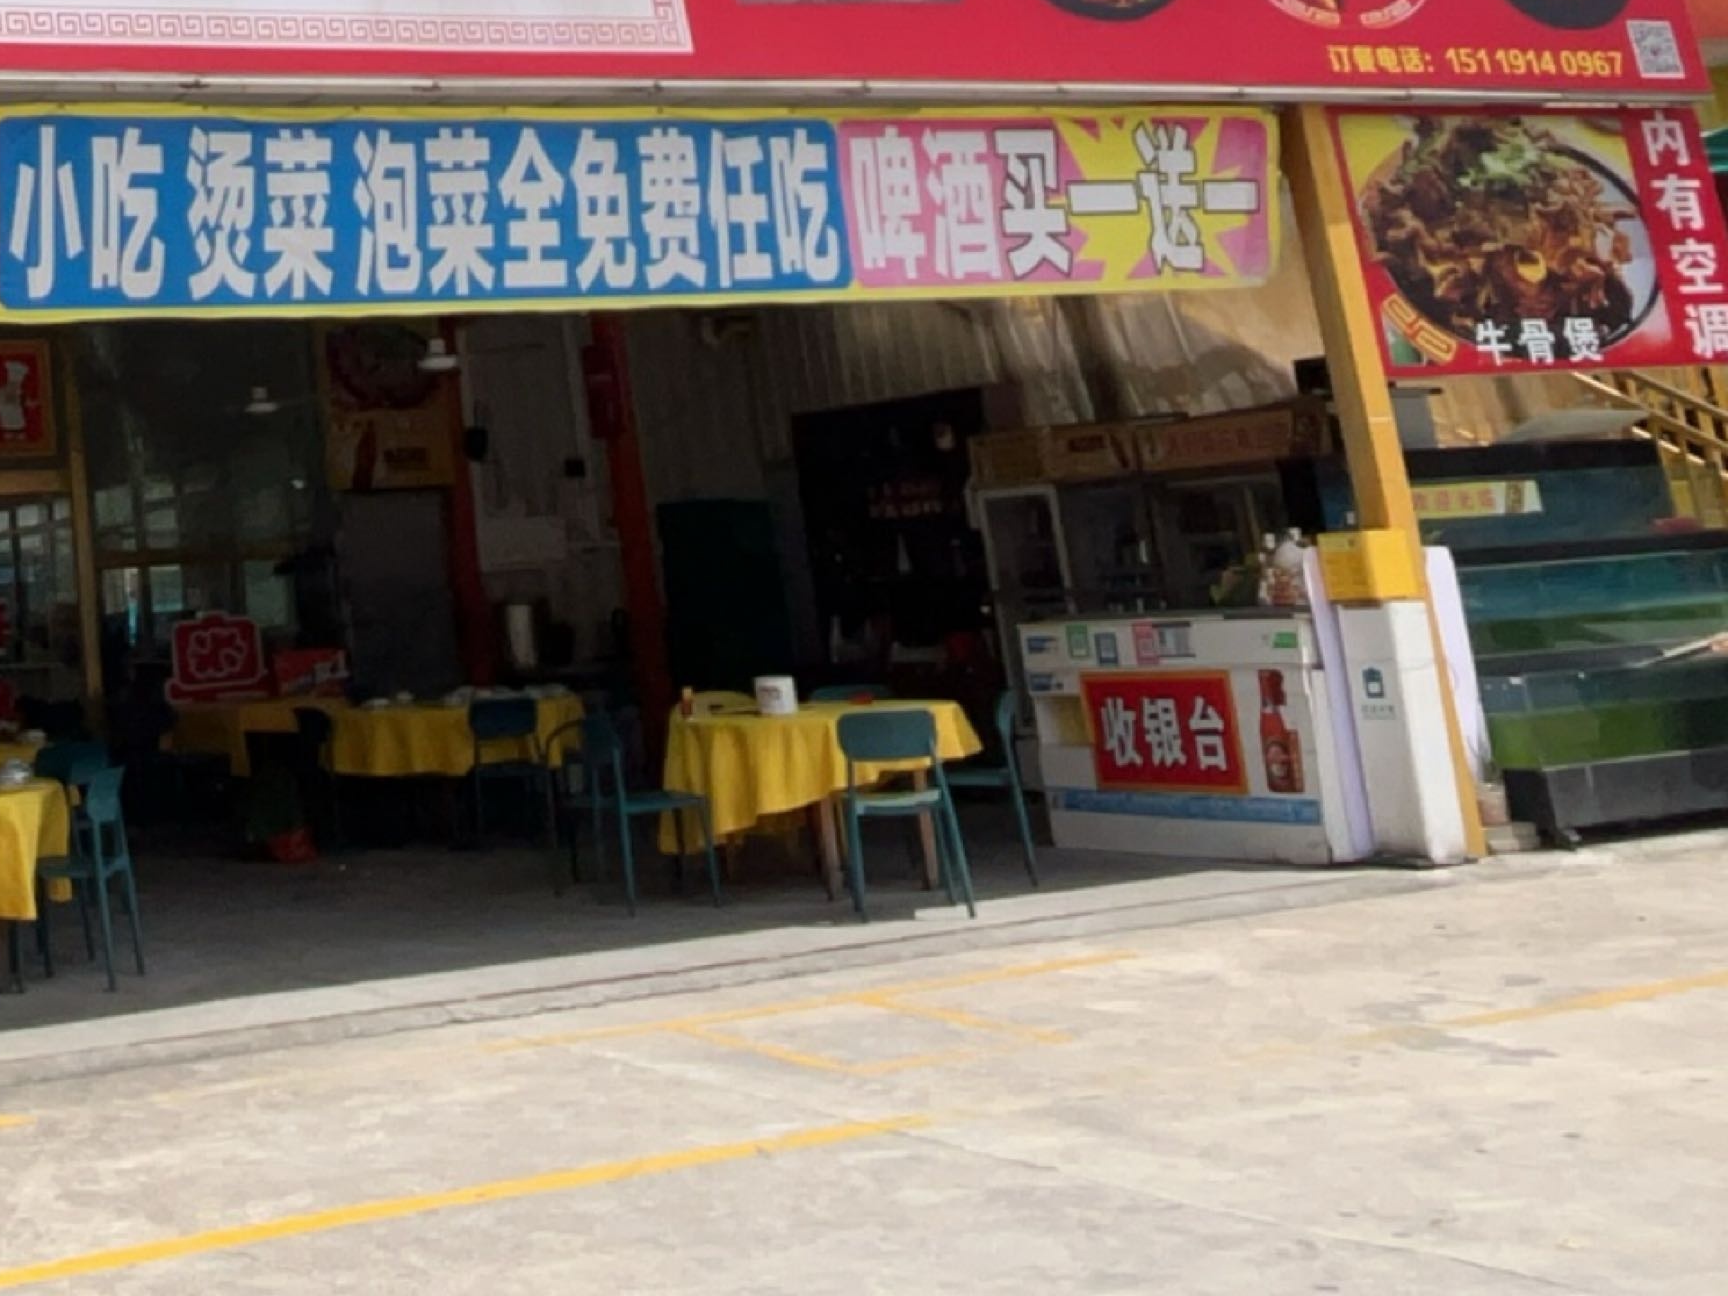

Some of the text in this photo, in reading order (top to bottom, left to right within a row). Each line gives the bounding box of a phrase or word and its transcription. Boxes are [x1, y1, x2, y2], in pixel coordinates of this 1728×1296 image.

[849, 120, 1260, 280] 啤酒买一送一
[1640, 110, 1728, 359] 内有空调
[1475, 318, 1603, 366] 牛骨煲
[1100, 696, 1228, 772] 收银台
